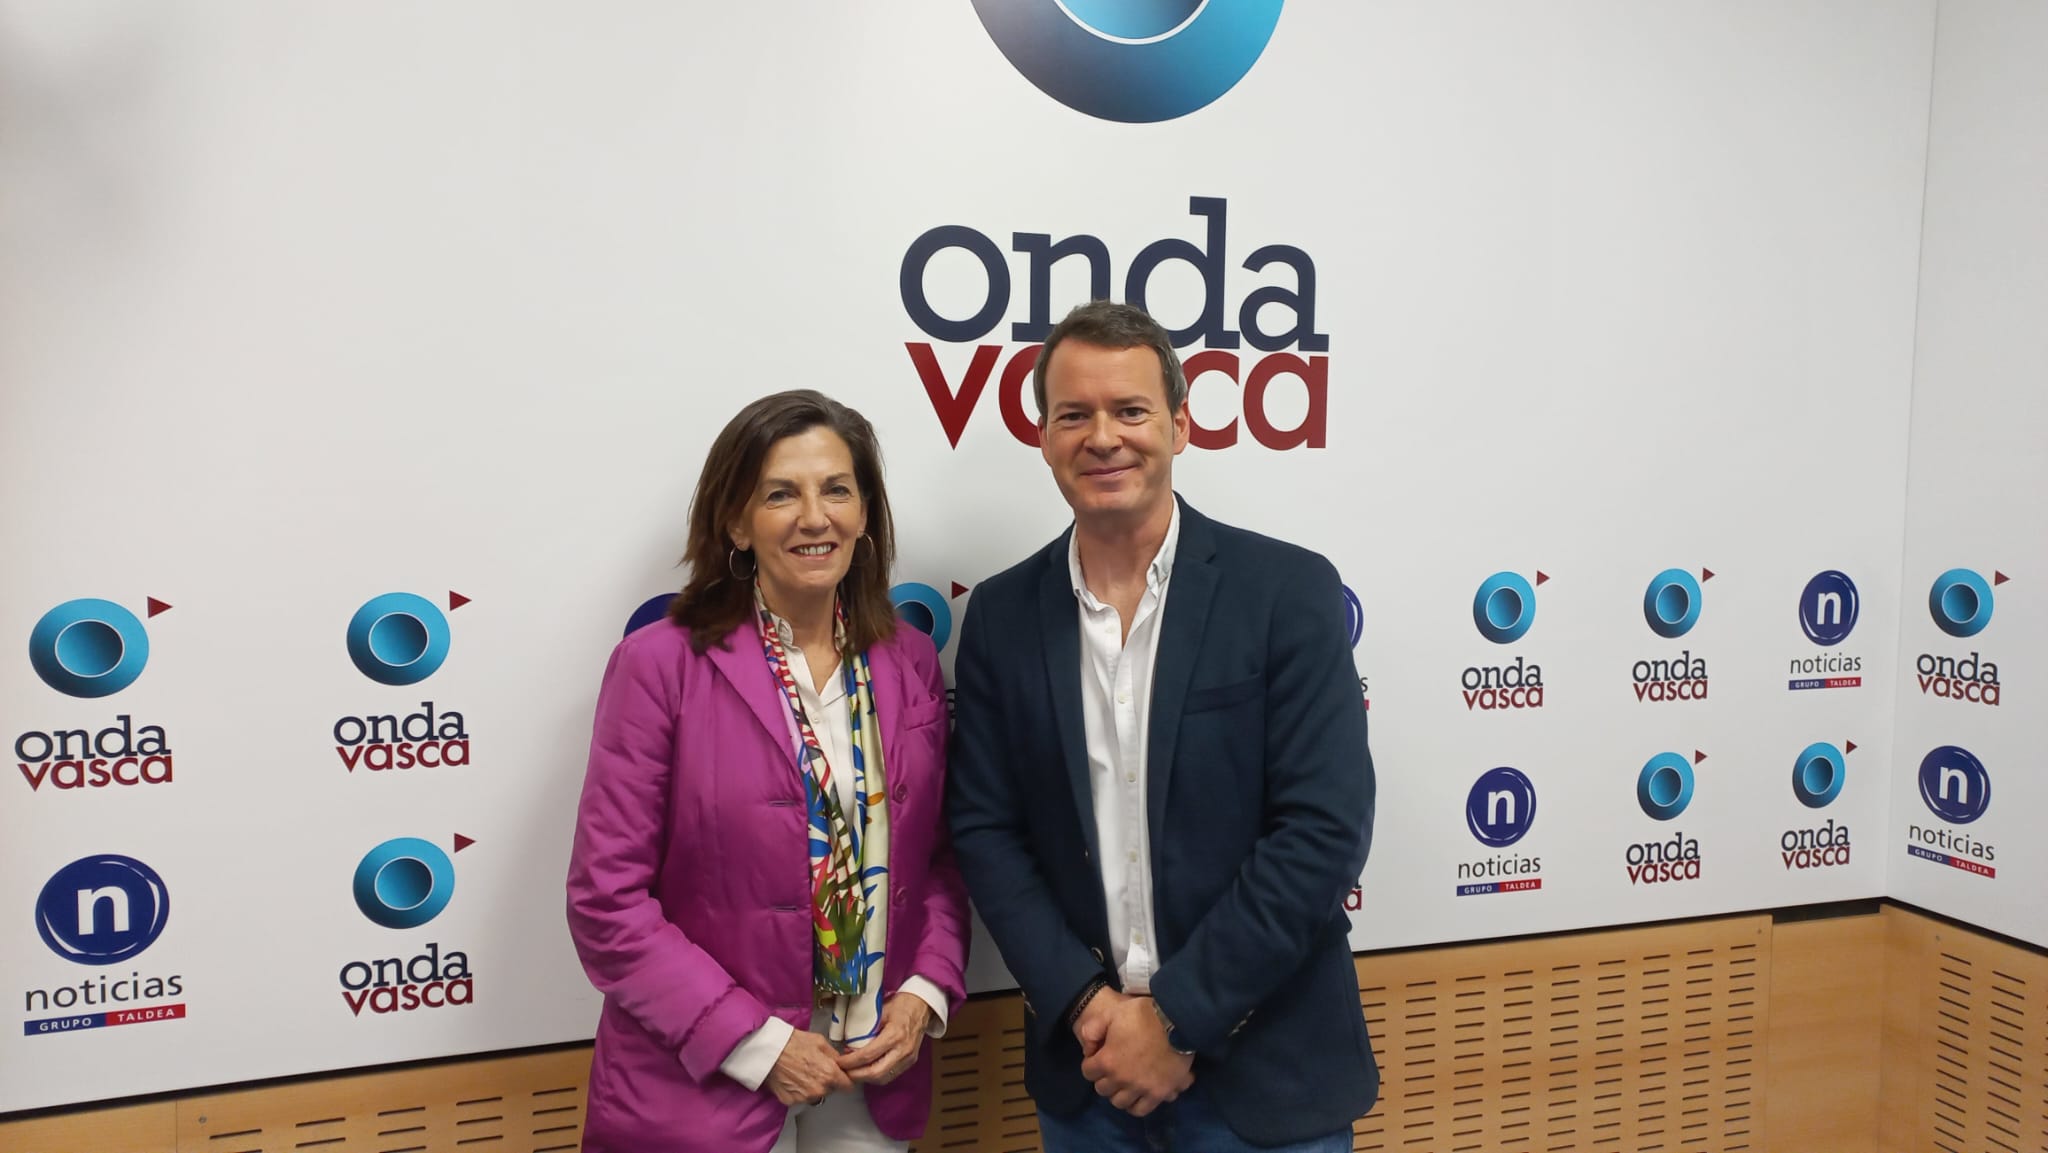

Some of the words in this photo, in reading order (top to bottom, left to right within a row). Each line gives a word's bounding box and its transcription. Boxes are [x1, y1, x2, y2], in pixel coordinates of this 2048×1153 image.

[899, 196, 1330, 352] onda
[1816, 591, 1841, 625] n
[1461, 657, 1543, 691] onda
[1632, 651, 1708, 685] onda
[1790, 653, 1862, 675] noticias
[1916, 652, 2000, 686] onda
[1463, 676, 1543, 711] vasca
[1634, 675, 1708, 703] vasca
[1795, 681, 1819, 689] GRUPO
[1830, 679, 1857, 687] TALDEA
[1918, 674, 2001, 707] vasca
[14, 715, 172, 763] onda
[334, 702, 469, 747] onda
[17, 754, 173, 793] vasca
[336, 740, 470, 773] vasca
[1939, 766, 1968, 806] n
[1487, 790, 1515, 825] n
[1626, 833, 1700, 866] onda
[1781, 820, 1850, 854] onda
[1909, 824, 1995, 861] noticias
[1458, 853, 1541, 879] noticias
[1627, 856, 1700, 887] vasca
[1782, 843, 1850, 870] vasca
[1914, 848, 1943, 862] GRUPO
[1956, 860, 1989, 875] TALDEA
[1464, 885, 1492, 894] GRUPO
[1505, 881, 1536, 891] TALDEA
[77, 886, 130, 936] n
[339, 943, 473, 991] onda
[25, 971, 183, 1012] noticias
[342, 978, 474, 1017] vasca
[39, 1017, 92, 1031] GRUPO
[117, 1008, 175, 1022] TALDEA
